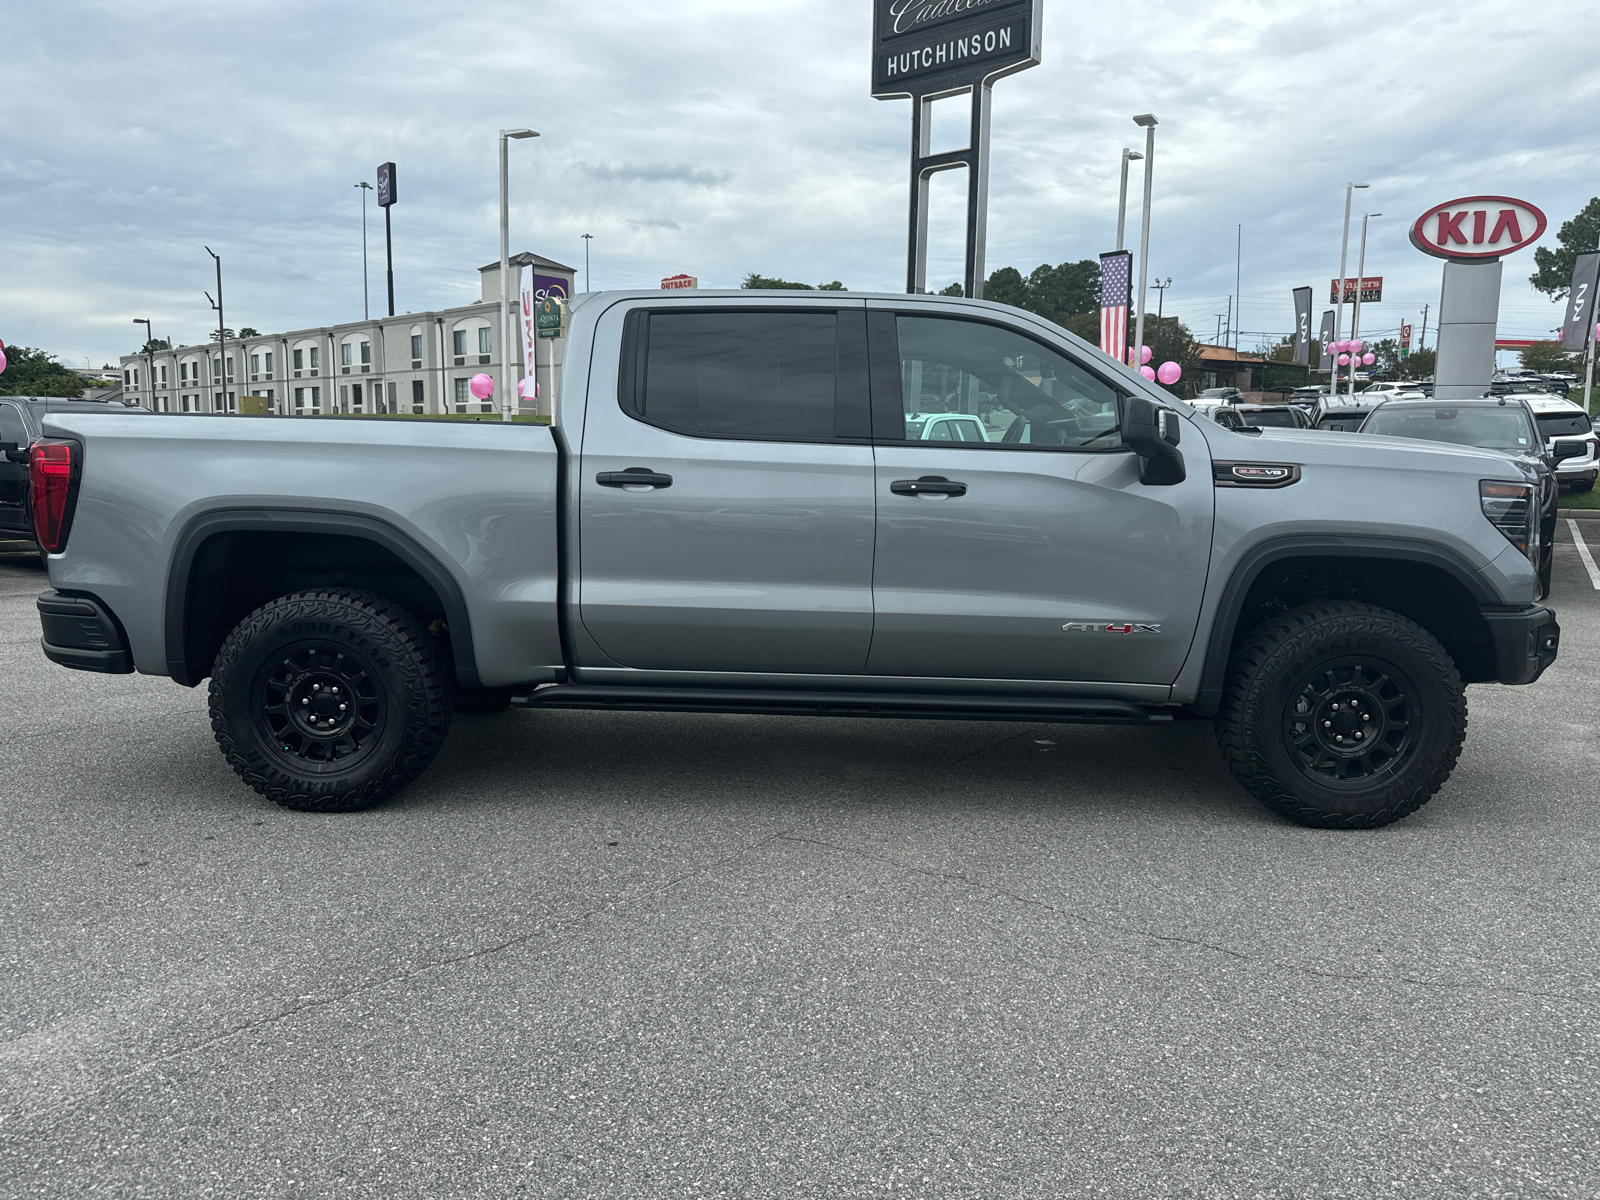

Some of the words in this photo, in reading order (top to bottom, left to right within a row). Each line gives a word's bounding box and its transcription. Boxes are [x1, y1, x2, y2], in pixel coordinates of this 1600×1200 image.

[887, 27, 1011, 76] HUTCHINSON
[1437, 209, 1523, 245] KIA
[661, 280, 692, 289] OUTBACK
[1062, 622, 1161, 635] AT4X
